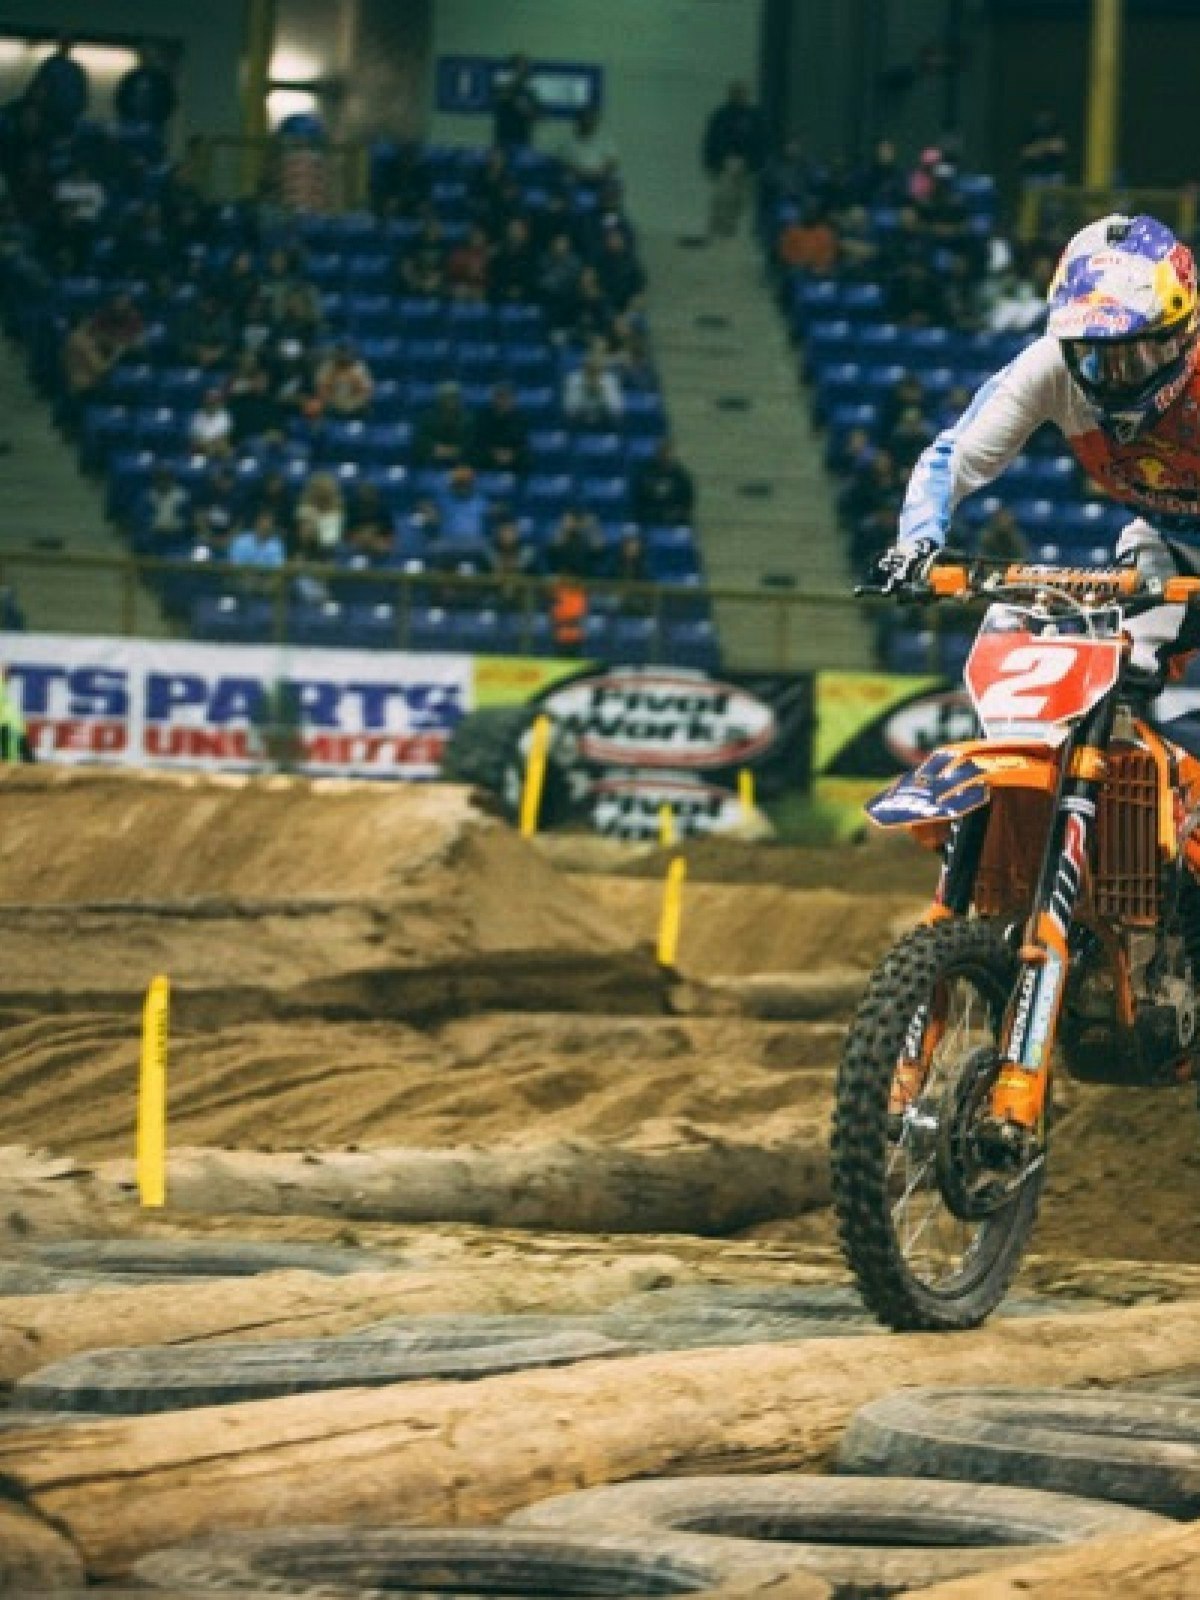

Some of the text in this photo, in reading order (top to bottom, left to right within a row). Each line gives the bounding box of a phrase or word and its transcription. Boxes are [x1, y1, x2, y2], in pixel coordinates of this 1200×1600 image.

[145, 672, 463, 728] PARTS
[980, 646, 1078, 718] 2
[144, 725, 444, 766] UNLMITED
